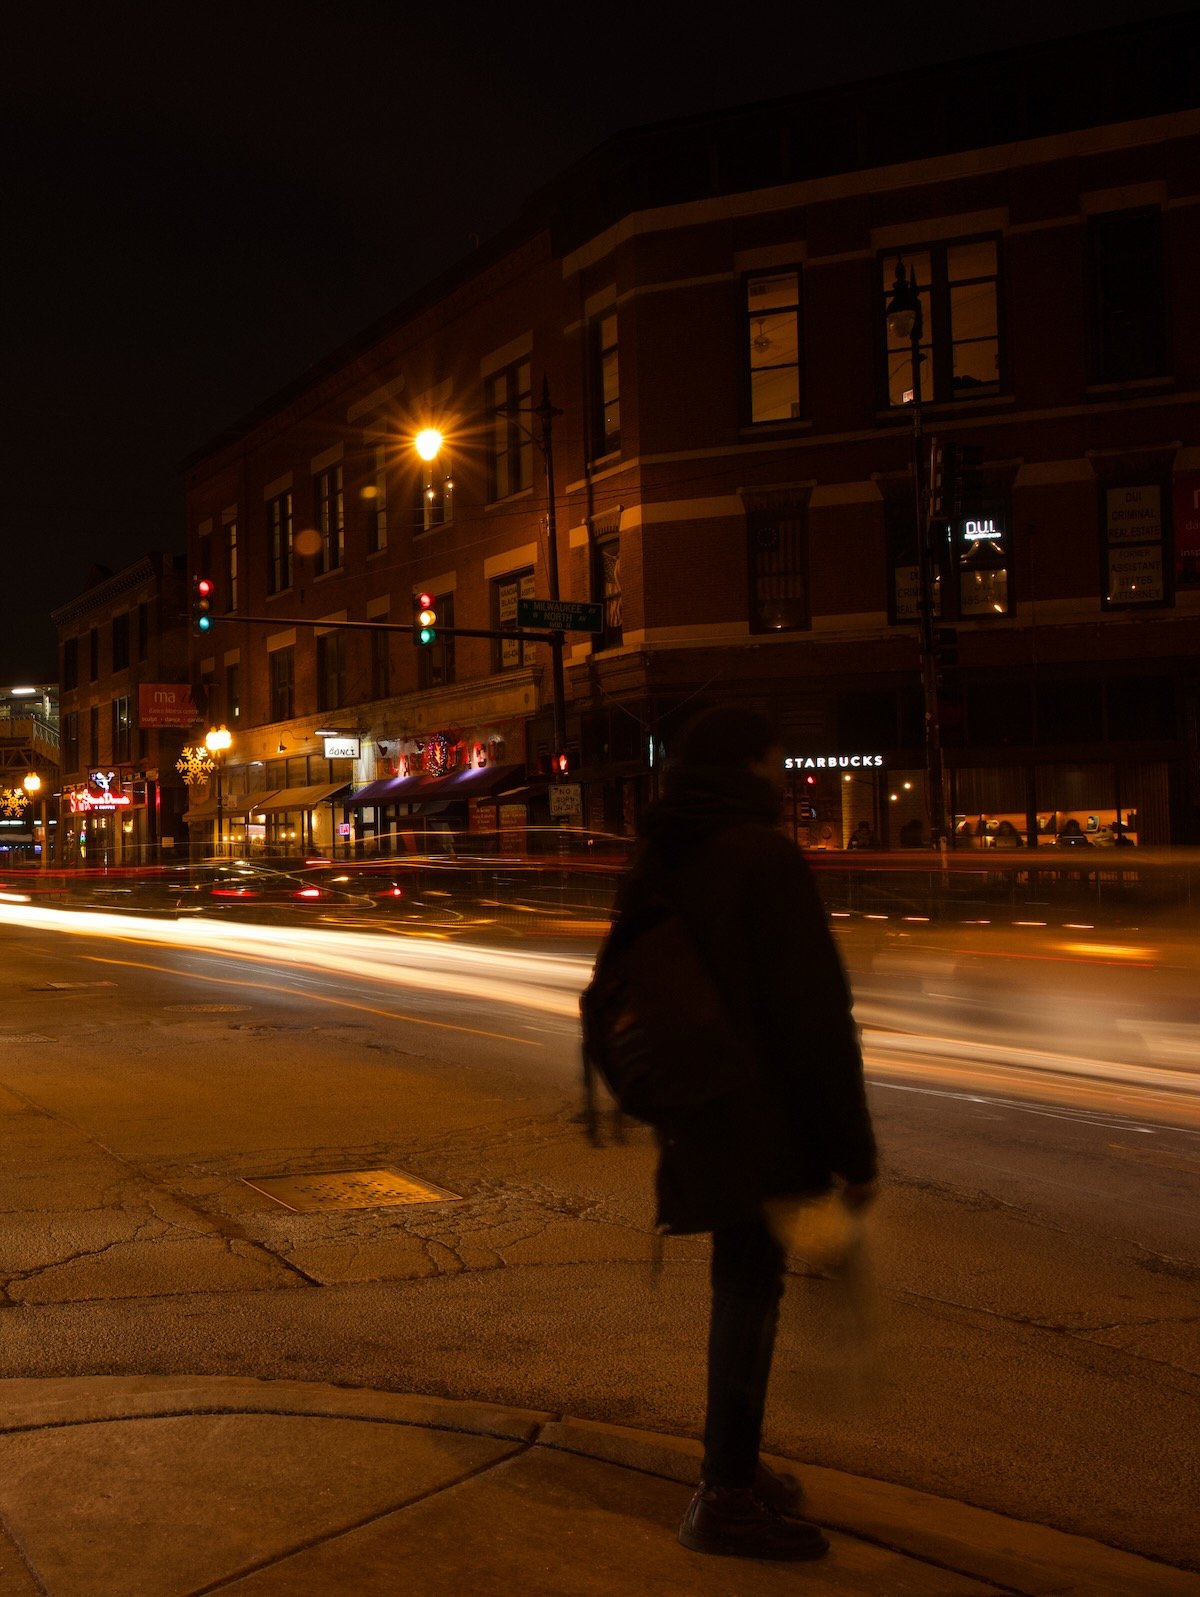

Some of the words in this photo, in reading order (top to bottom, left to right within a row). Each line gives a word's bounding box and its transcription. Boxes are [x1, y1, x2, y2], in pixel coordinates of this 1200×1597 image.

[533, 601, 583, 614] MILWAUKEE
[543, 611, 573, 622] NORTH
[784, 755, 883, 769] STARBUCKS
